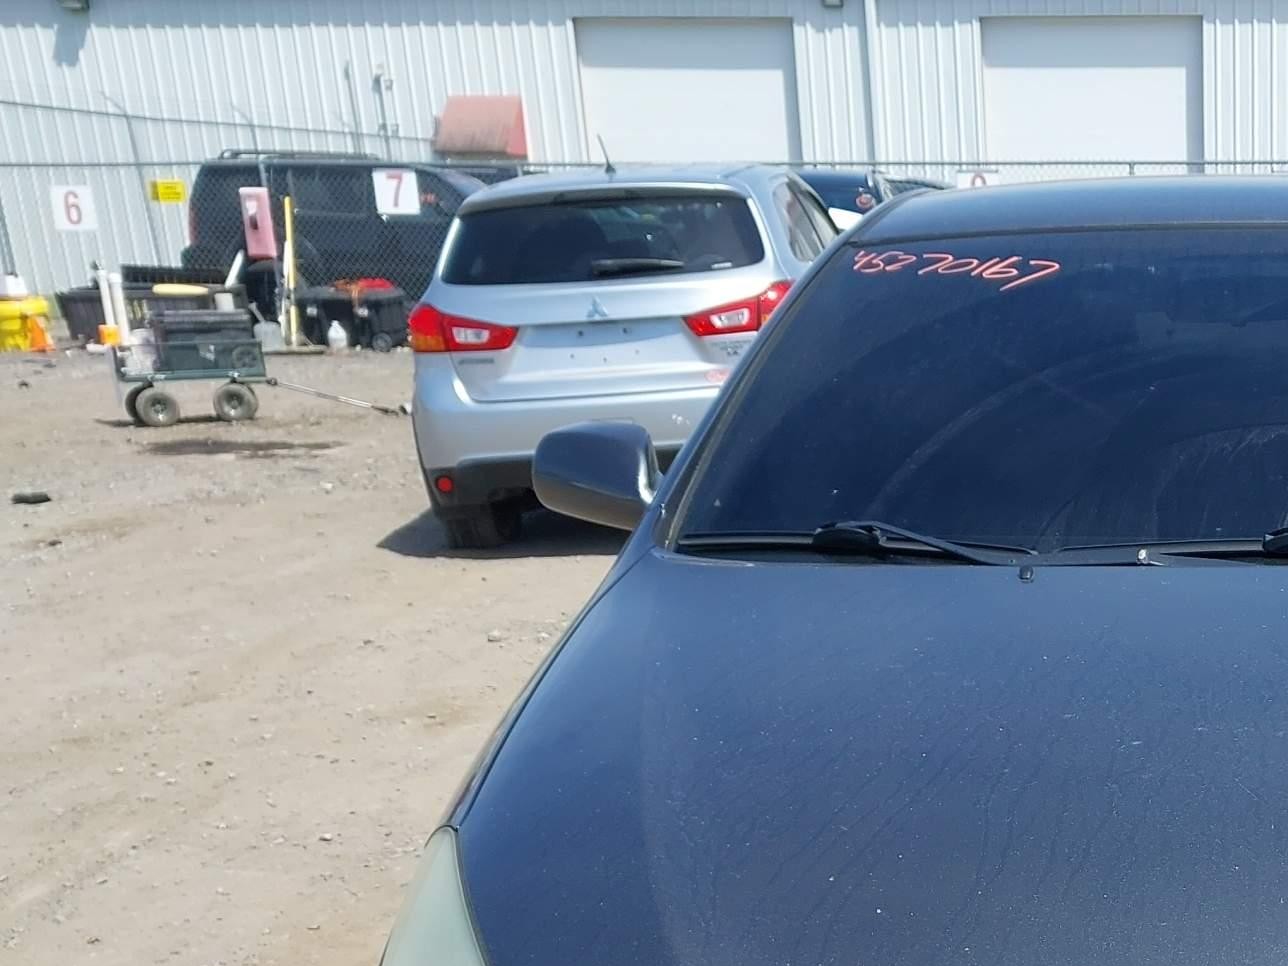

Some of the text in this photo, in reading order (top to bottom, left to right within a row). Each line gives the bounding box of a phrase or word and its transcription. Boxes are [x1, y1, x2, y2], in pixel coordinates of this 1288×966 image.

[63, 190, 82, 225] 6
[385, 171, 403, 208] 7
[853, 250, 1060, 291] 45270167
